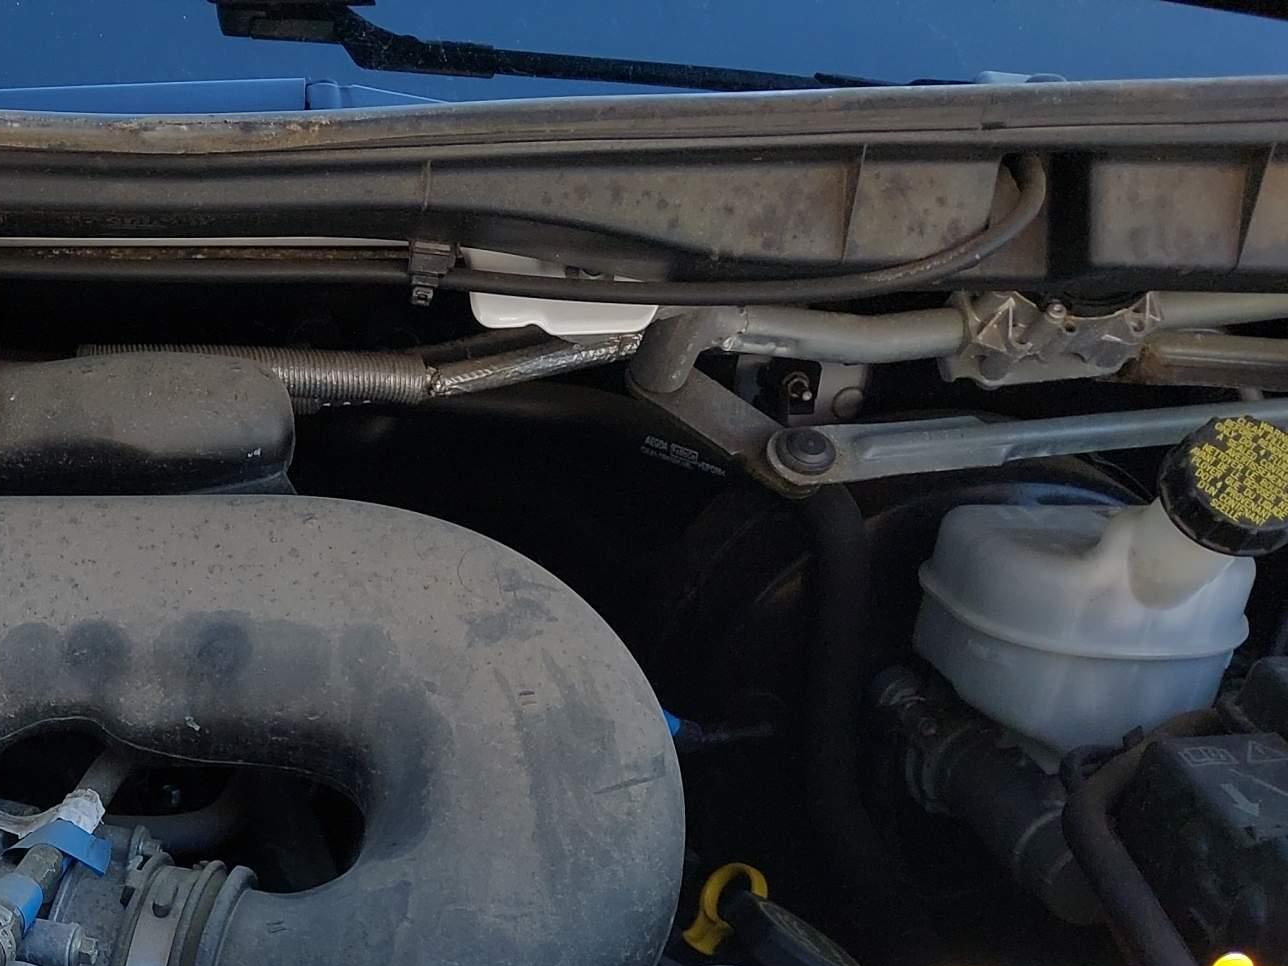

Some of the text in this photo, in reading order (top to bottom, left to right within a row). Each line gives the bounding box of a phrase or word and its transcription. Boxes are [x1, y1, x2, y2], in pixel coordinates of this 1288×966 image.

[1191, 446, 1216, 465] AVANT
[1202, 443, 1245, 472] NETTOYER
[1226, 438, 1258, 461] SEALED
[1239, 436, 1257, 451] DOT
[1266, 435, 1288, 453] FILLE
[1190, 456, 1223, 479] PLOYER
[1224, 476, 1244, 492] QUE
[1225, 447, 1288, 490] AVERTISSEMENT
[1195, 468, 1213, 483] DOT
[1224, 487, 1272, 521] PROVENANT
[1218, 493, 1266, 527] CONTENANT
